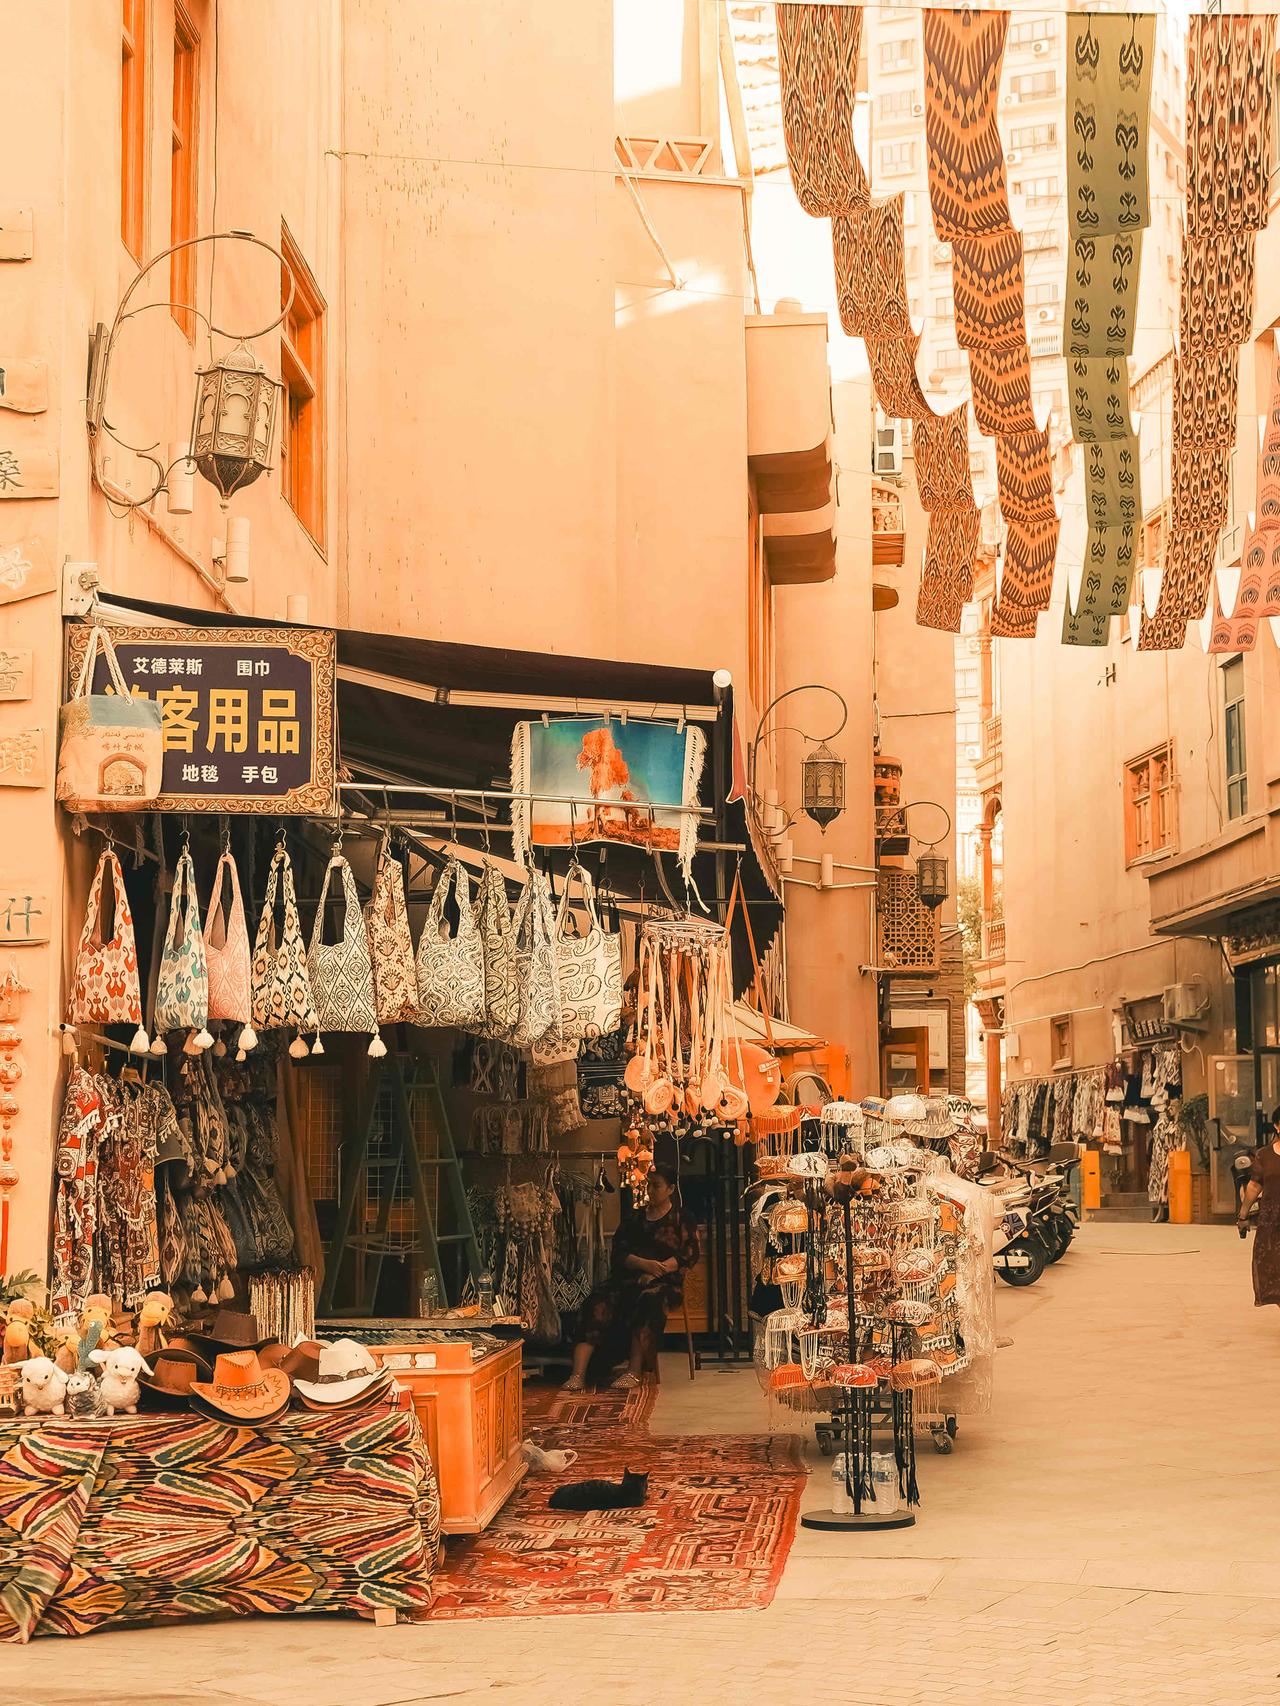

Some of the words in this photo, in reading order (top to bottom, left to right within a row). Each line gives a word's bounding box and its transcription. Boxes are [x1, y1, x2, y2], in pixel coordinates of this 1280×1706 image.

[133, 657, 203, 675] 艾德莱斯
[236, 660, 270, 677] 围巾
[105, 683, 300, 754] 客用品
[182, 764, 219, 782] 地毯
[241, 765, 278, 783] 手包
